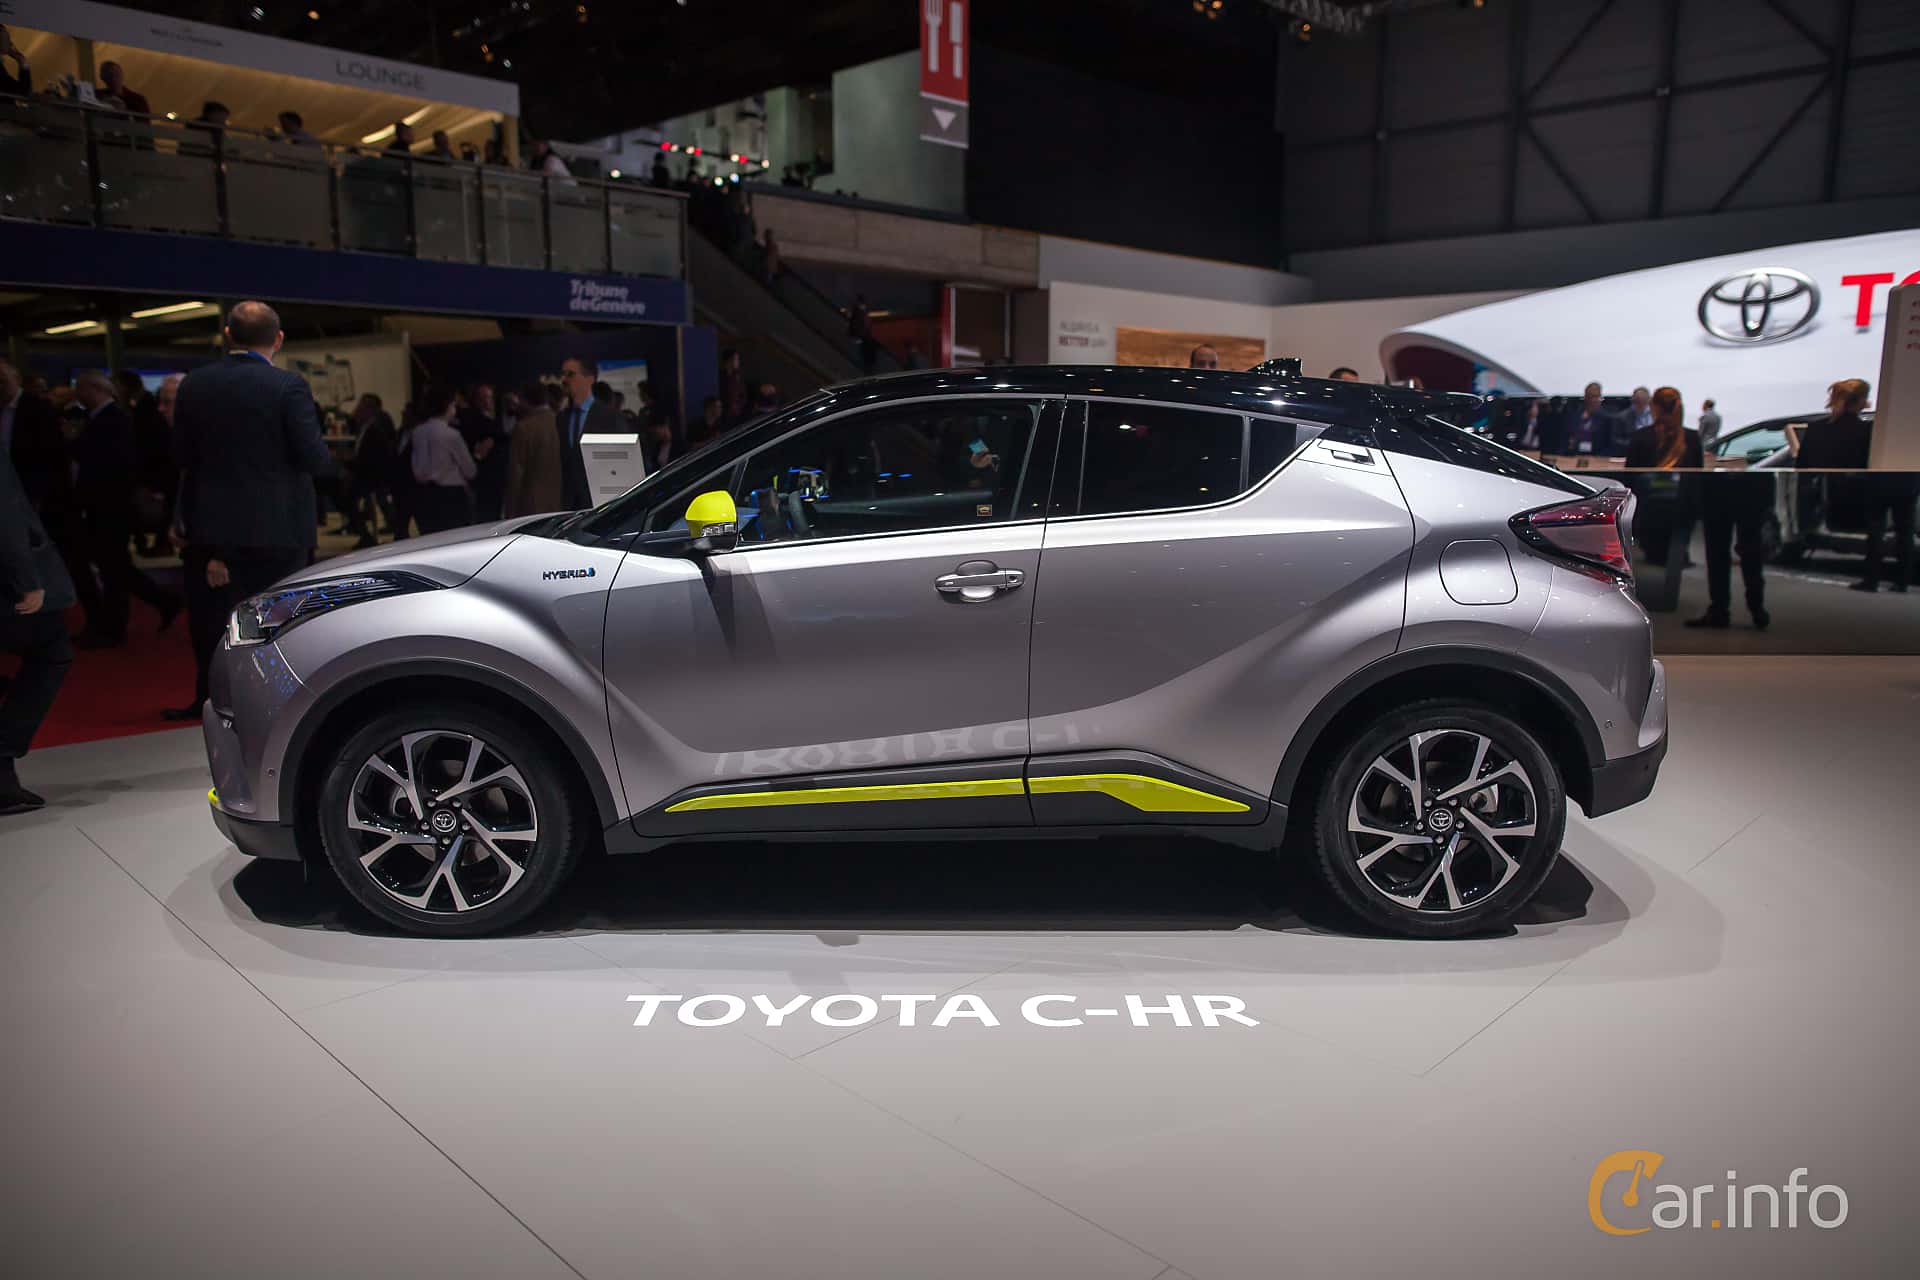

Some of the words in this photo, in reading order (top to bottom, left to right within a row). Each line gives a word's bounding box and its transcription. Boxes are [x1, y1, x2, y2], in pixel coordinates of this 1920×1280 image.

[335, 59, 425, 91] LOUNGE
[570, 280, 629, 299] Tribune
[1840, 269, 1920, 327] T
[542, 569, 588, 580] HYBRID
[625, 994, 1001, 1027] TOYOTA
[1020, 994, 1261, 1027] C-HR
